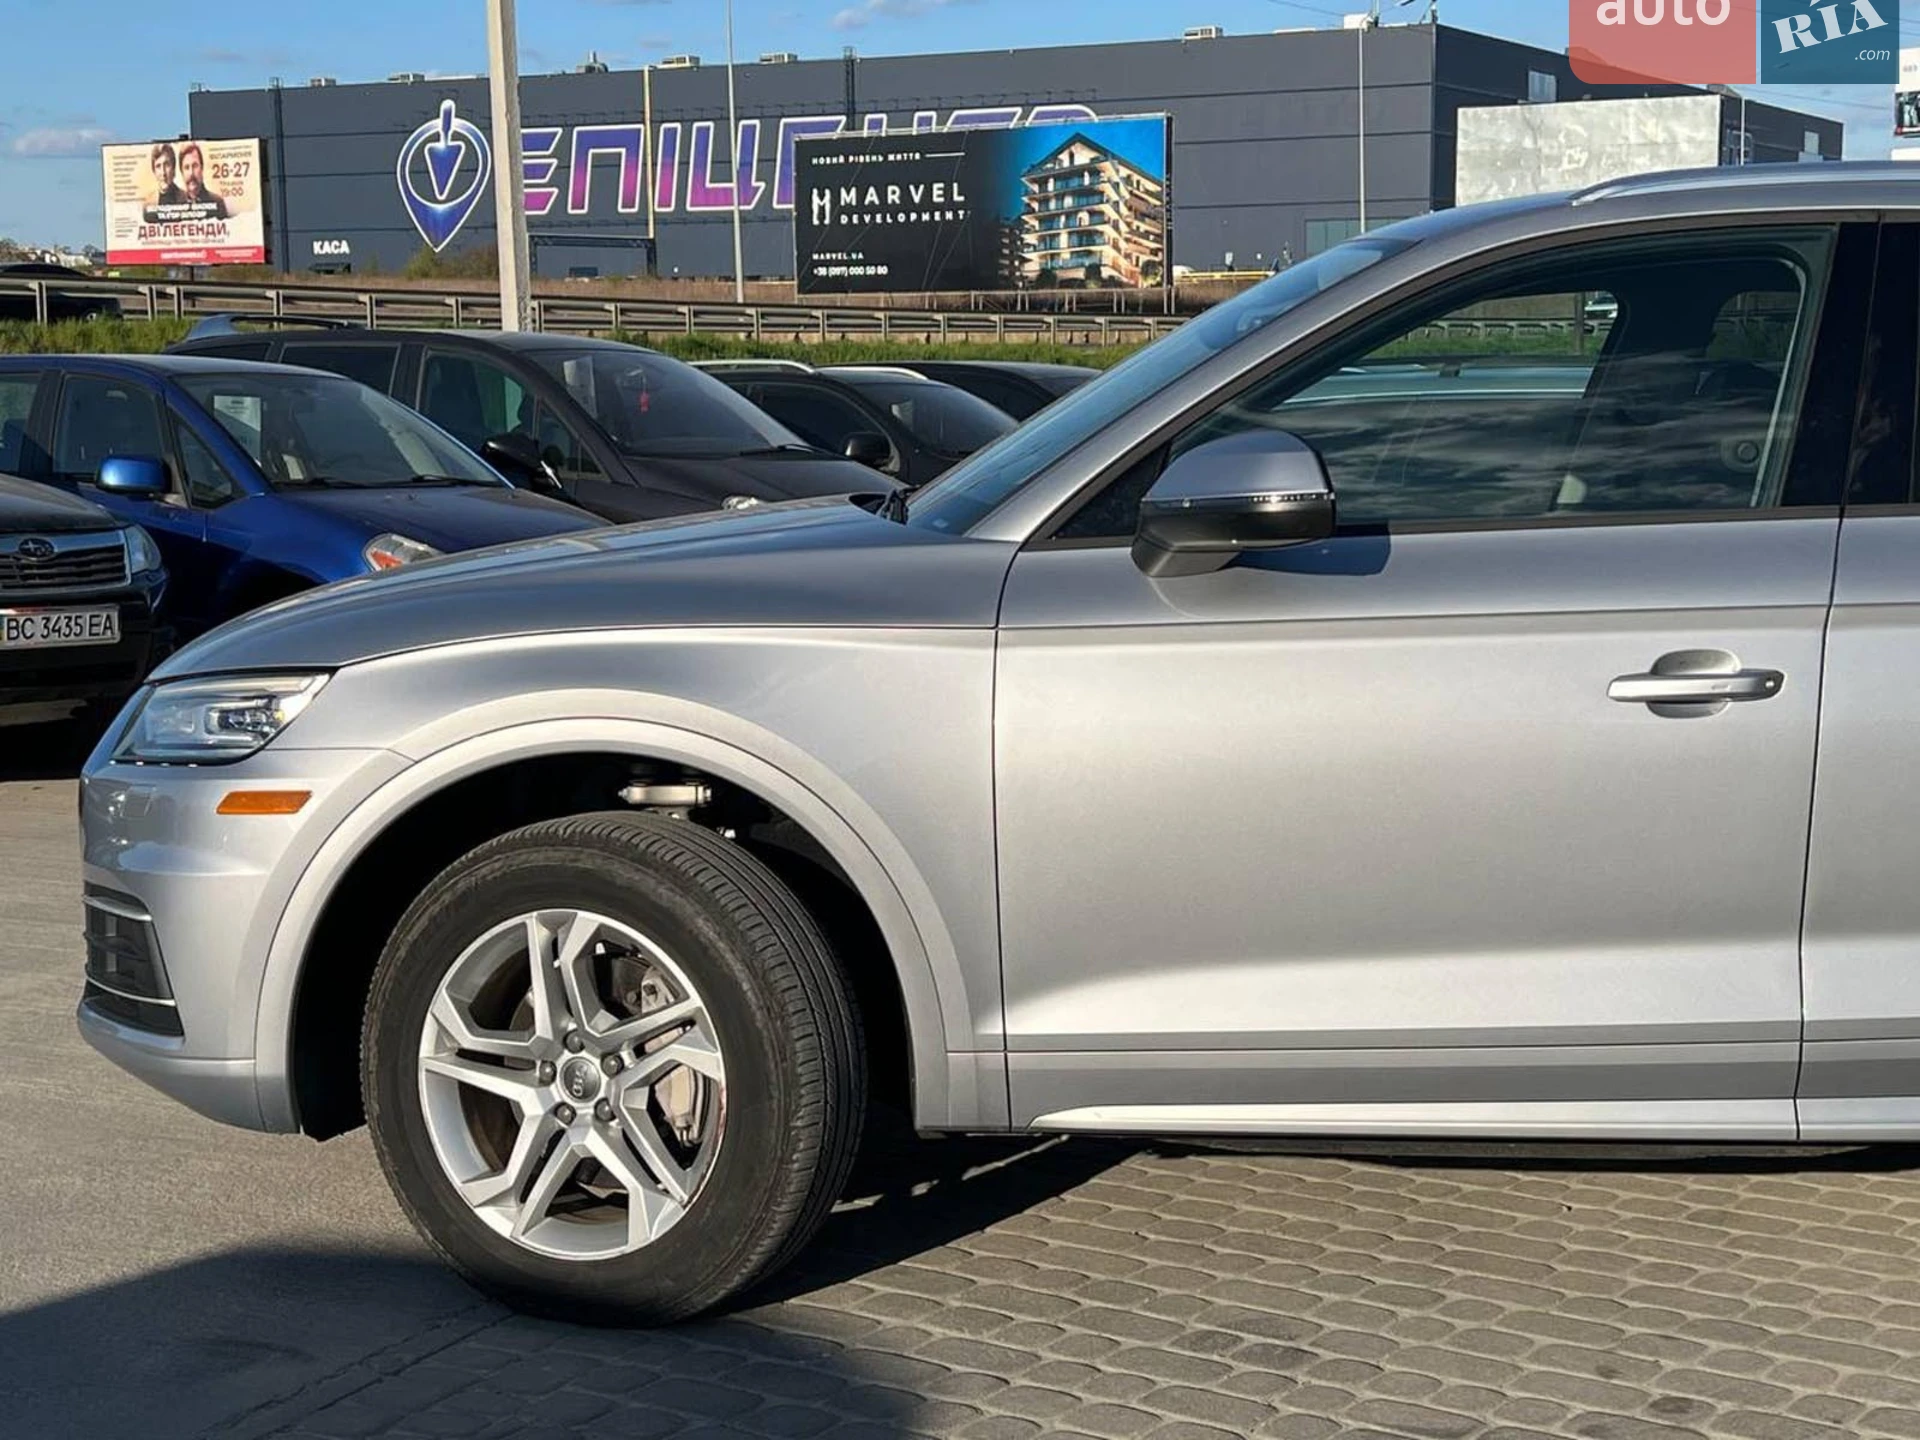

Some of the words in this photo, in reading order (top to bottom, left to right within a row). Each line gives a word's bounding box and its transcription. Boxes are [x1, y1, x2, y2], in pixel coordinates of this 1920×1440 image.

[811, 154, 845, 165] НОВИЙ
[848, 154, 884, 164] РІВЕНЬ
[887, 152, 921, 162] ЖИТТЯ
[840, 182, 965, 206] MARVEL
[840, 209, 966, 225] DEVELOPMENT
[138, 225, 160, 240] ДВІ
[312, 239, 350, 255] КАСА
[849, 266, 865, 275] 000
[6, 617, 35, 640] BC
[41, 615, 83, 639] 3435
[88, 613, 114, 636] EA
